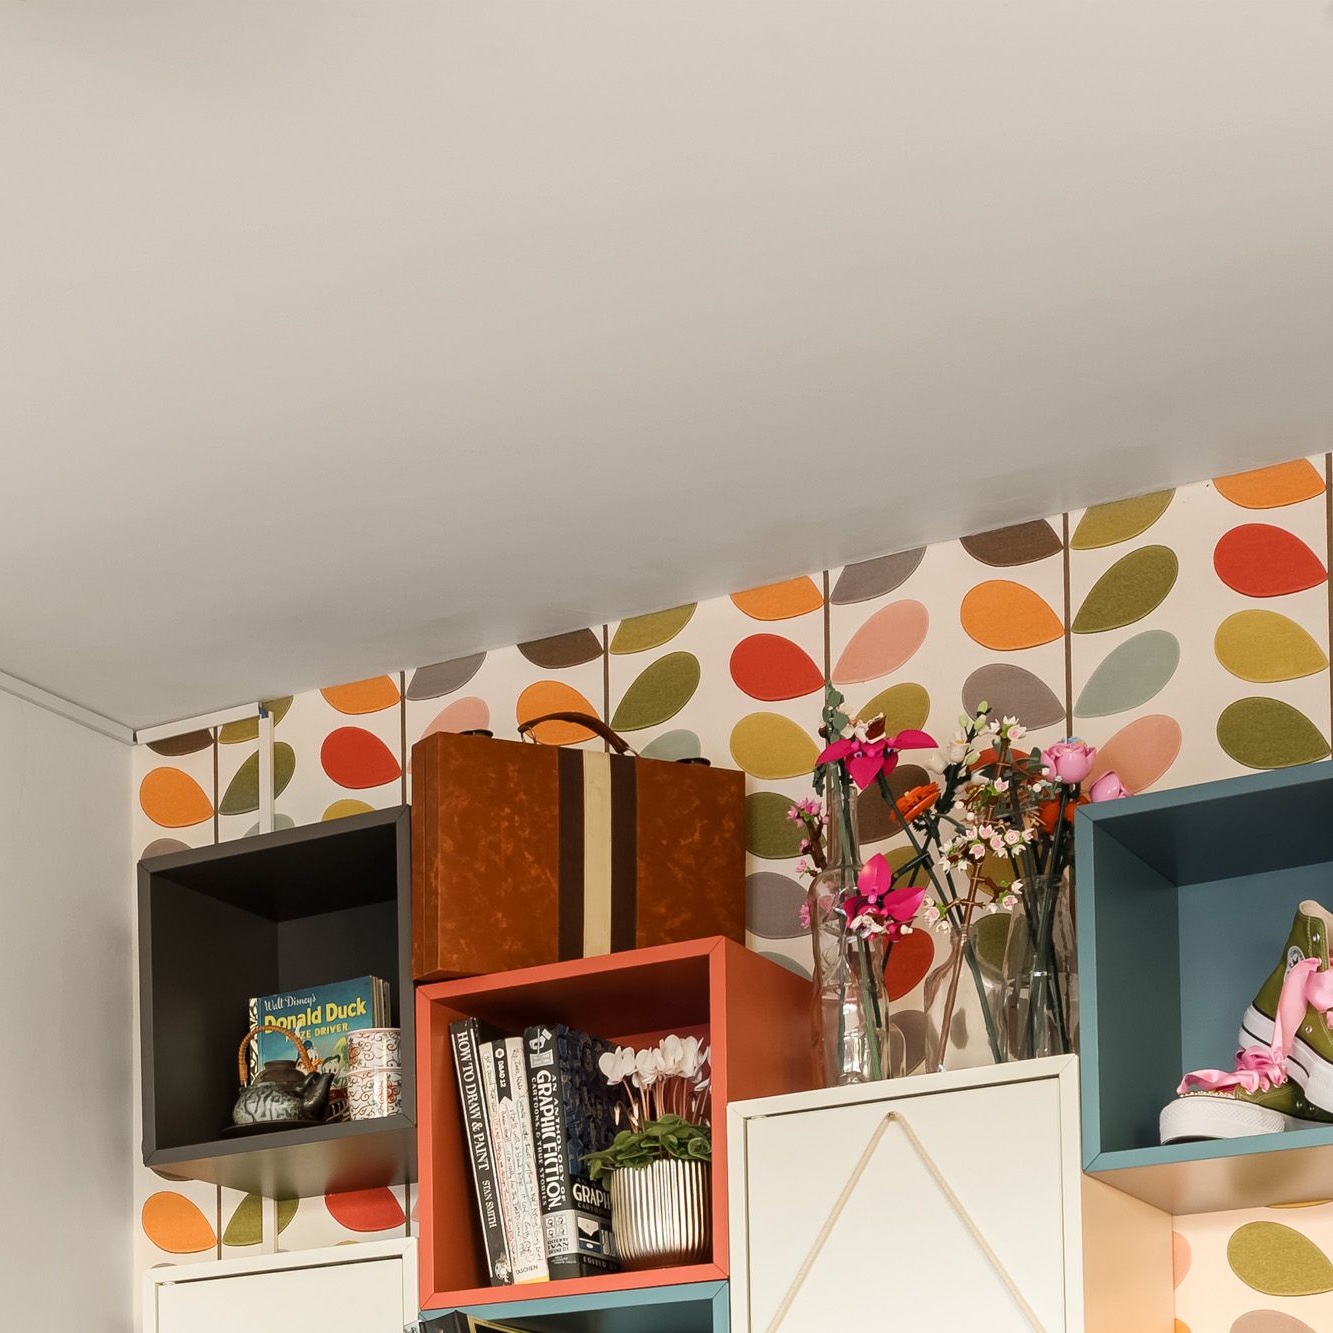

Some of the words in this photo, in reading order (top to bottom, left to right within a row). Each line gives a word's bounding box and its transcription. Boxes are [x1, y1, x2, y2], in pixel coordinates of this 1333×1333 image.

[264, 996, 283, 1011] Walt
[264, 1006, 322, 1034] Donald
[326, 997, 366, 1022] Duck
[315, 1023, 348, 1037] DRIVER
[457, 1030, 472, 1062] HOW
[462, 1063, 475, 1082] TO
[552, 1074, 557, 1091] AN
[466, 1085, 481, 1119] DRAW
[536, 1070, 556, 1140] GRAPHIC
[471, 1121, 483, 1132] &
[553, 1098, 566, 1182] ANTHOLOGY
[473, 1136, 489, 1171] PAINT
[482, 1180, 494, 1200] STAN
[539, 1167, 547, 1206] STORIES
[561, 1186, 566, 1201] OF
[572, 1183, 611, 1209] GRAPH
[485, 1201, 497, 1228] SMITH
